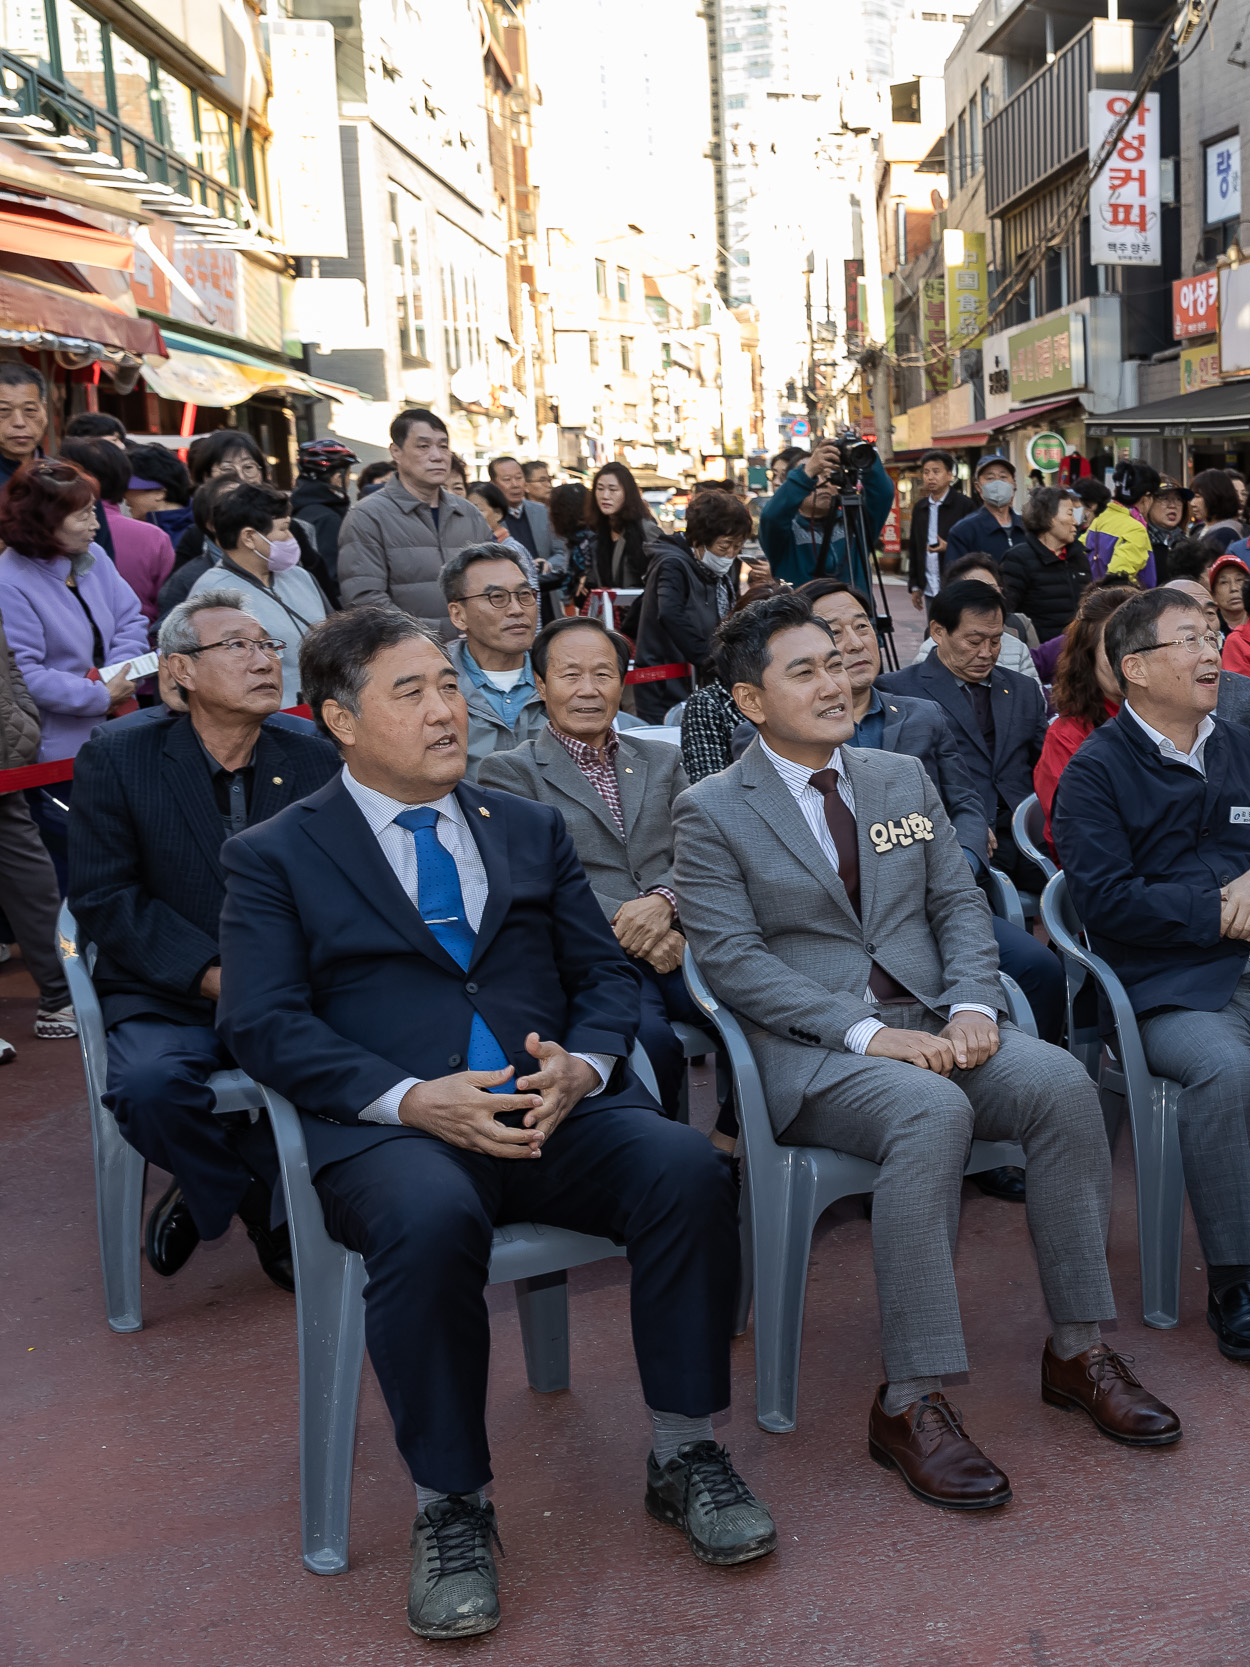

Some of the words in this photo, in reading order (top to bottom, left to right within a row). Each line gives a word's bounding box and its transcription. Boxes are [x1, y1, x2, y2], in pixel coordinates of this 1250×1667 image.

[1106, 97, 1150, 233] 아성커피
[1217, 149, 1232, 199] 랑
[869, 812, 935, 853] 오신환
